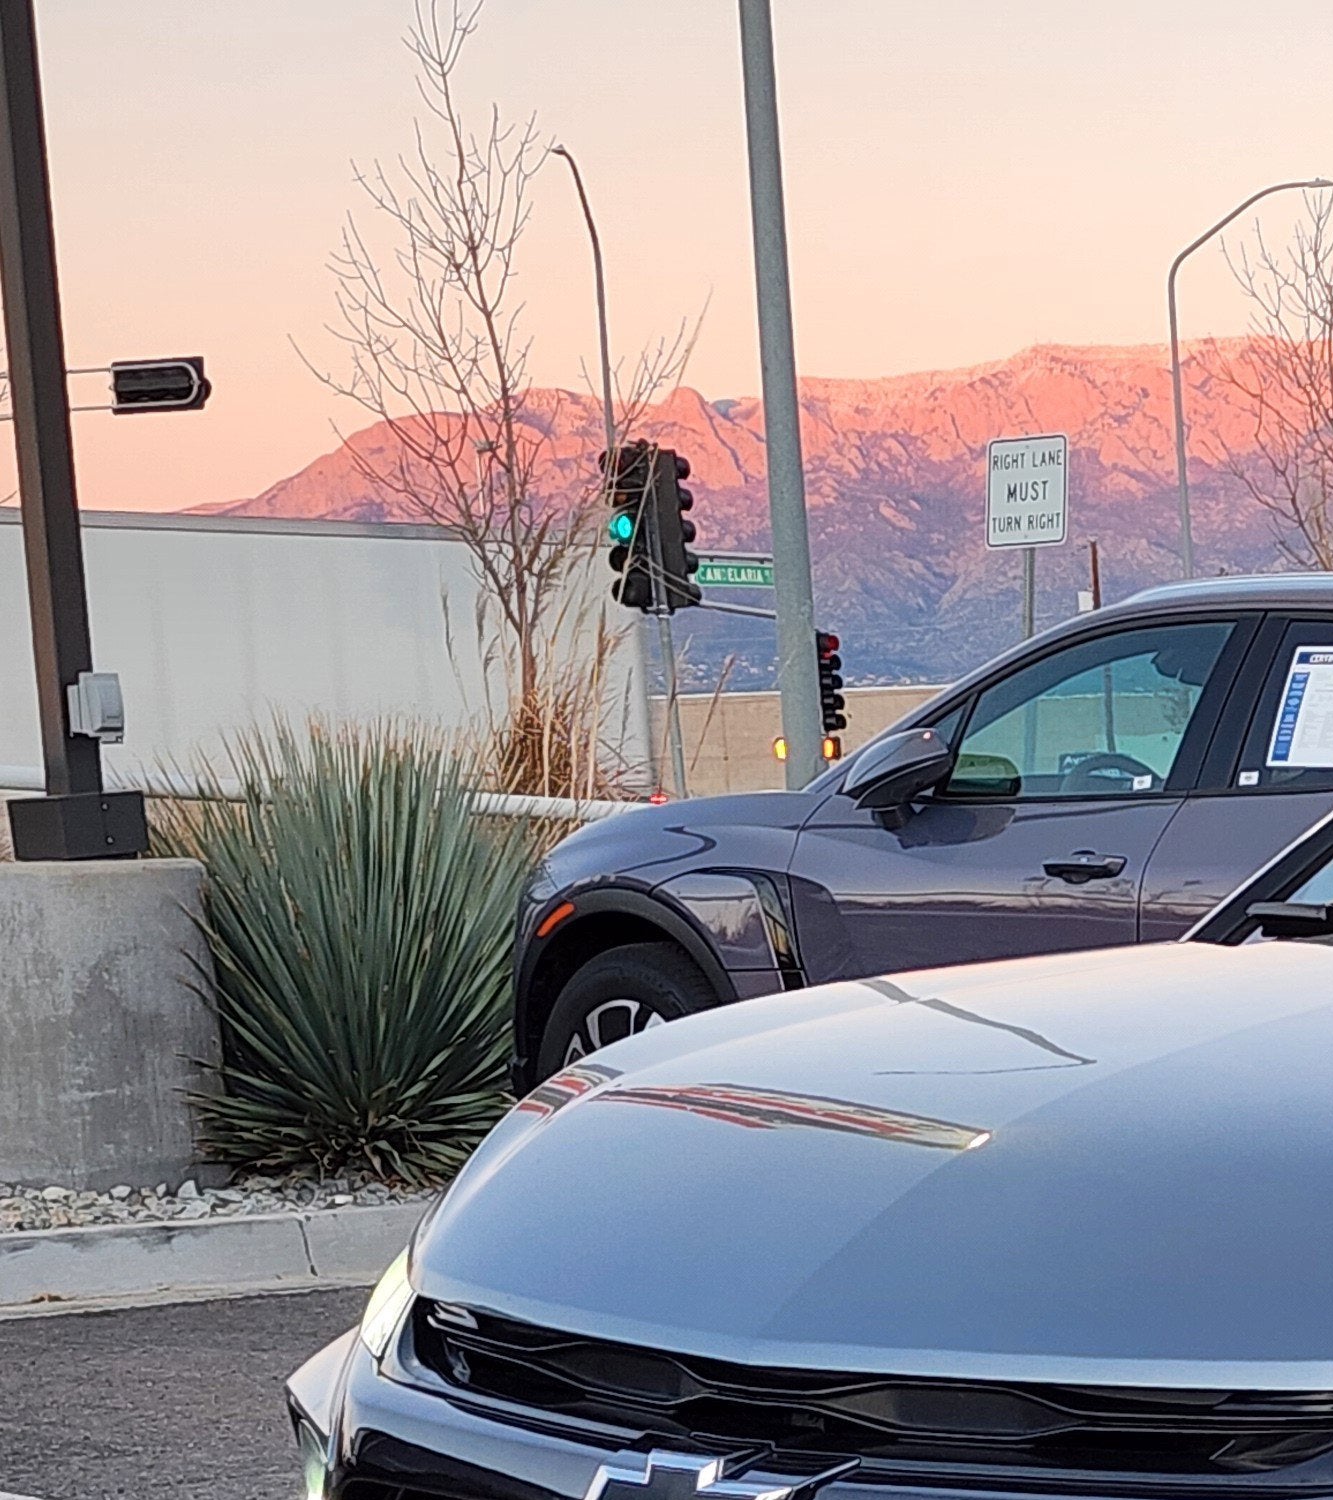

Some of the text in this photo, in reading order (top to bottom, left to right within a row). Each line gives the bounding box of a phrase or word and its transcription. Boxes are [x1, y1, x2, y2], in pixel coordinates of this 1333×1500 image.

[992, 449, 1063, 471] RIGHT LANE
[1006, 480, 1049, 503] MUST
[992, 512, 1061, 534] TURN RIGHT
